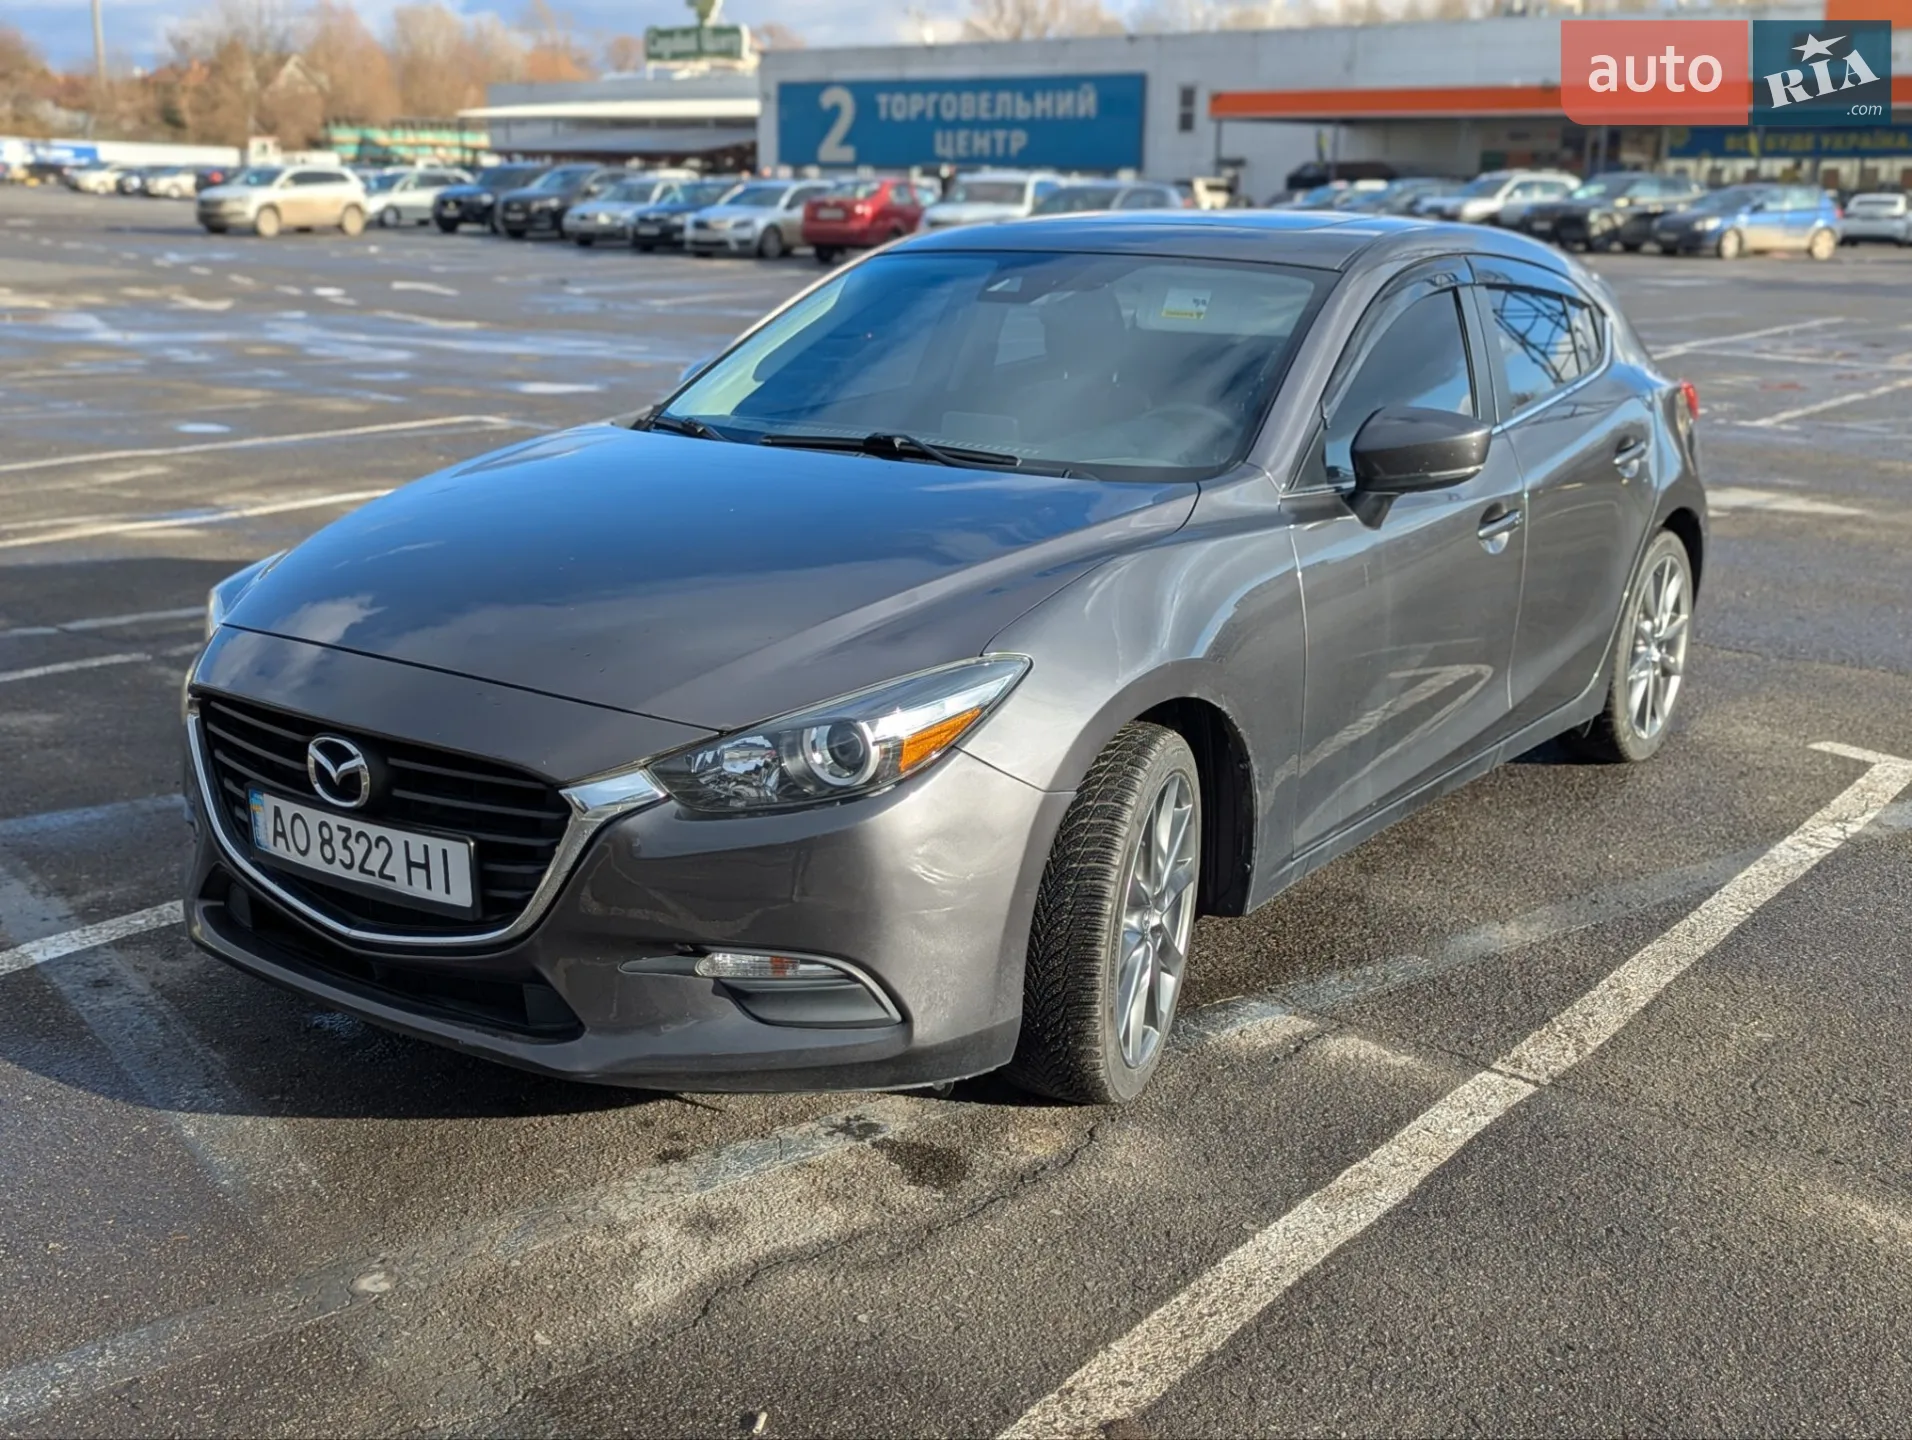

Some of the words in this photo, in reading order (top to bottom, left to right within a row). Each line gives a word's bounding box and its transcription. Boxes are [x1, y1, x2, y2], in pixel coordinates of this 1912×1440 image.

[816, 86, 857, 164] 2
[875, 82, 1098, 122] ТОРГОВЕЛЬНИЙ
[933, 128, 1029, 159] ЦЕНТР
[272, 804, 312, 858] AO
[317, 819, 397, 883] 8322
[403, 839, 451, 896] HI
